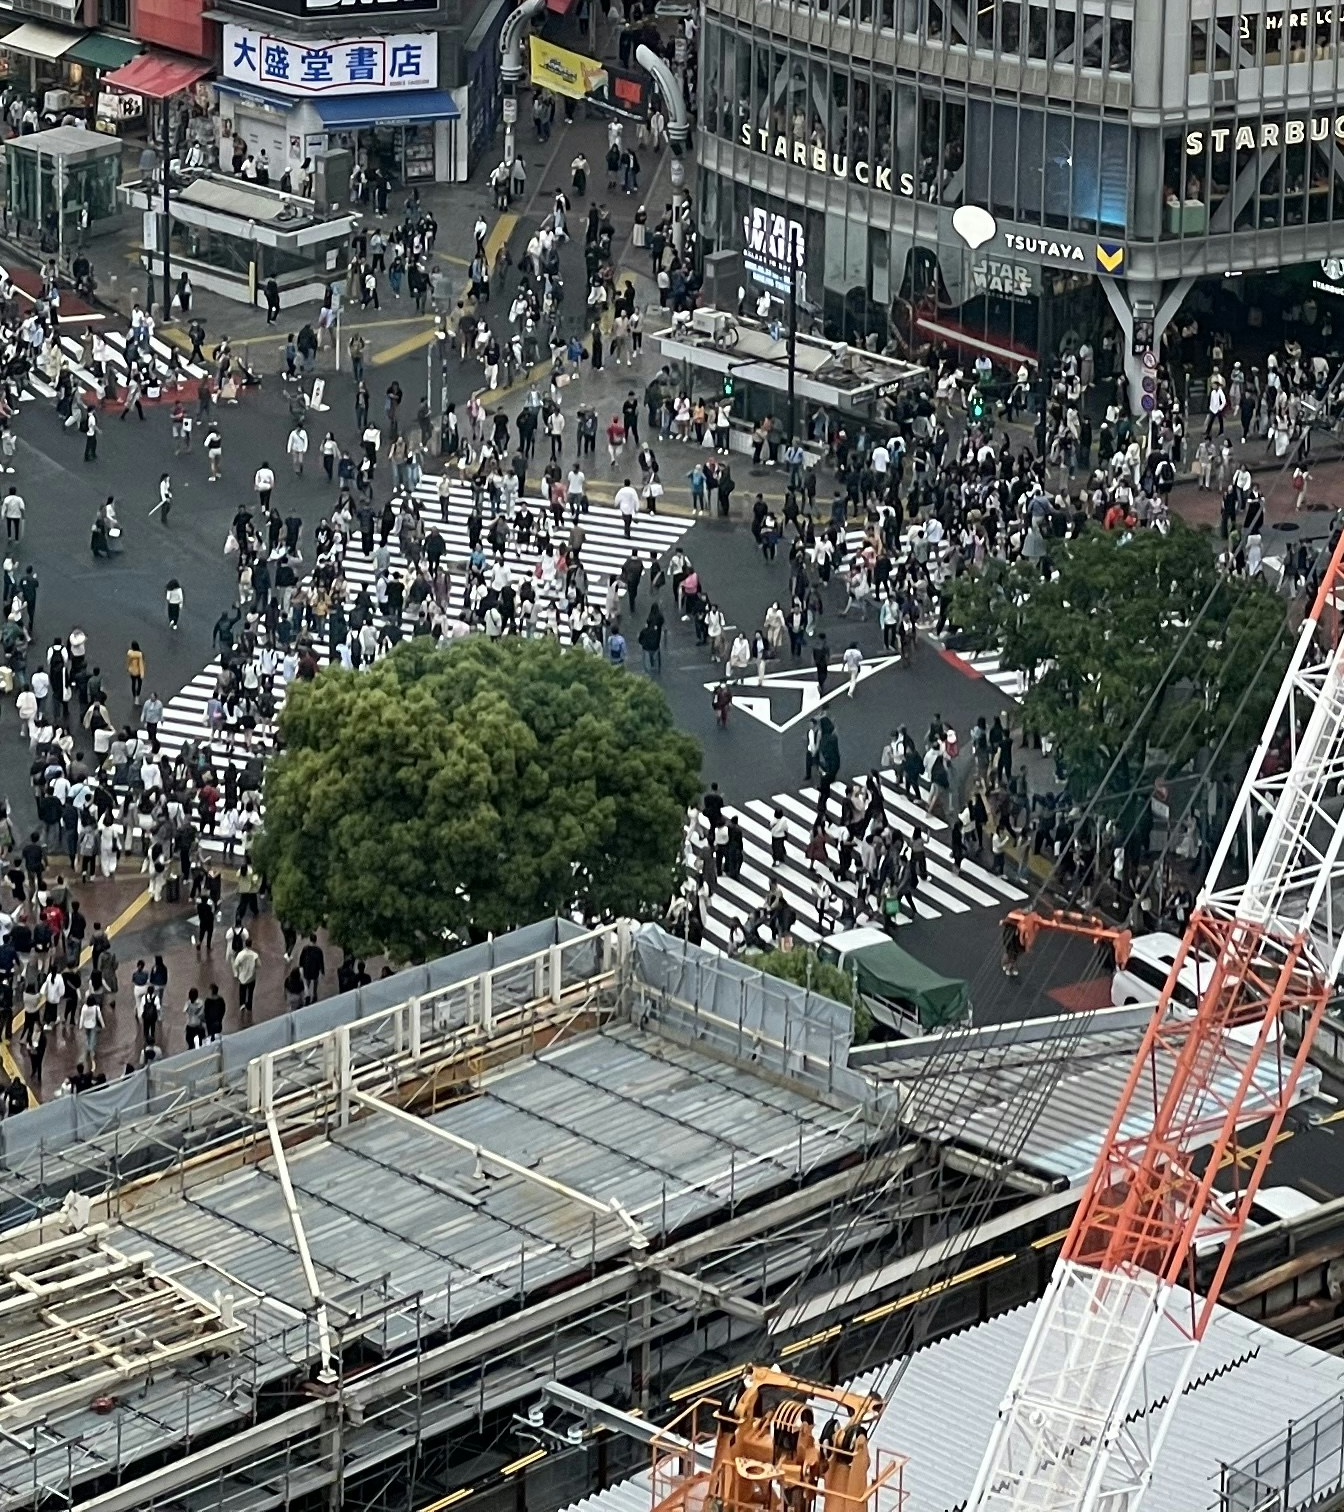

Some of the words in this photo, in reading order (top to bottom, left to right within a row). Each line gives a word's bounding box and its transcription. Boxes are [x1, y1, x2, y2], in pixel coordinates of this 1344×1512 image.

[233, 36, 422, 83] 大盛堂書店
[741, 123, 914, 196] STARBUCKS
[1004, 233, 1085, 262] TSUTAYA
[973, 259, 1032, 283] STAR
